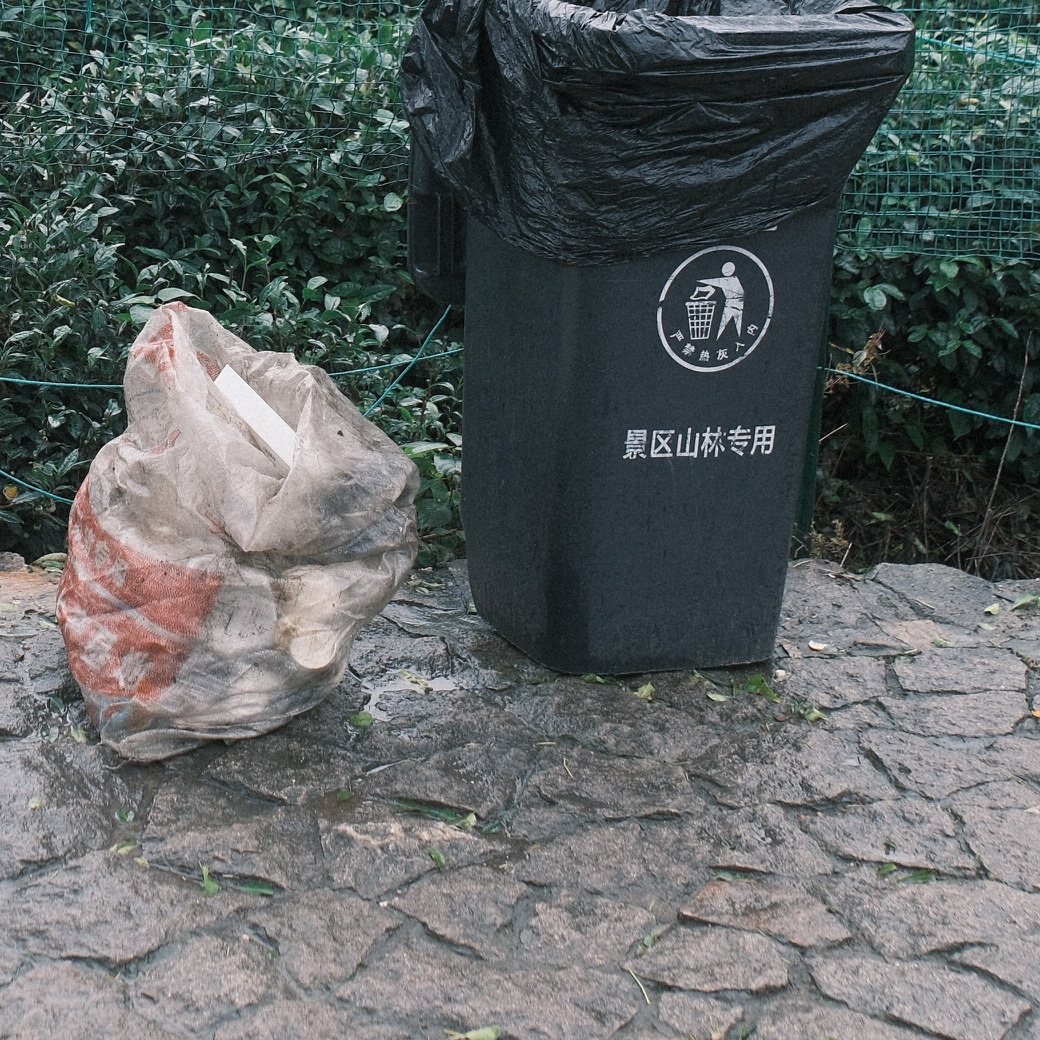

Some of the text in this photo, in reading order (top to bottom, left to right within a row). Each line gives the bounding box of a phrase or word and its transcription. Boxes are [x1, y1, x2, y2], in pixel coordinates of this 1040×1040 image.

[669, 323, 759, 362] 严禁热灰入内
[622, 425, 776, 460] 景区山林专用
